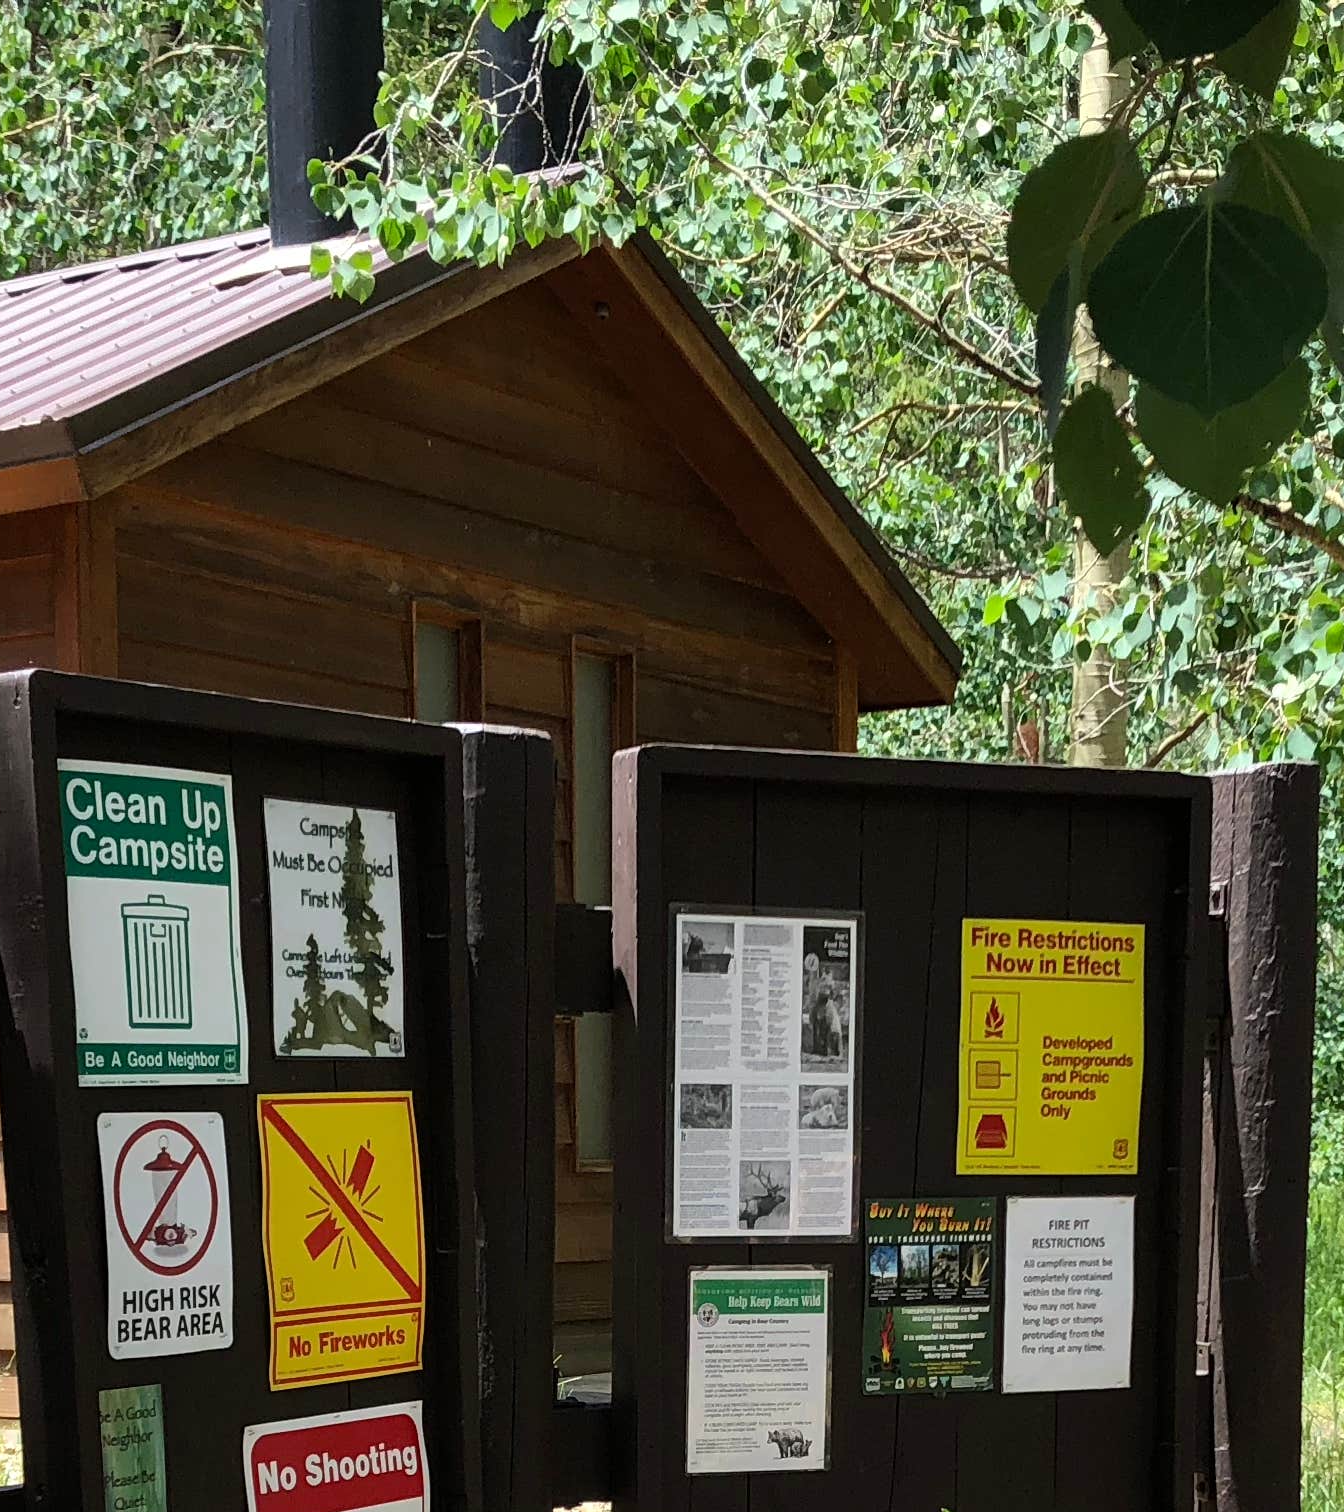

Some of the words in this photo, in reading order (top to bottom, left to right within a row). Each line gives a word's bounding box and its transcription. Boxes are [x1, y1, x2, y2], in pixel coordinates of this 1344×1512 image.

[66, 777, 167, 825] Clean
[181, 788, 221, 838] Up
[299, 817, 362, 849] Campsi
[70, 825, 224, 875] Campsite
[273, 850, 304, 870] Must
[307, 853, 325, 872] Be
[301, 889, 329, 908] First
[971, 926, 1011, 948] Fire
[1018, 928, 1135, 953] Restrictions
[986, 952, 1034, 974] Now
[1040, 954, 1056, 974] in
[1063, 955, 1121, 977] Effect
[1043, 1036, 1113, 1051] Developed
[85, 1052, 104, 1067] Be
[111, 1051, 122, 1067] A
[127, 1052, 162, 1067] Good
[168, 1051, 220, 1070] Neighbor
[1042, 1053, 1133, 1070] Campgrounds
[1042, 1071, 1066, 1083] and
[1070, 1070, 1109, 1083] Picnic
[1041, 1087, 1096, 1100] Grounds
[1041, 1104, 1071, 1120] Only
[1048, 1219, 1071, 1231] FIRE
[1074, 1219, 1090, 1231] PIT
[1032, 1237, 1105, 1249] RESTRICTIONS
[1037, 1258, 1077, 1269] campfires
[1079, 1259, 1099, 1267] must
[1102, 1257, 1113, 1267] be
[1023, 1273, 1069, 1284] completely
[1071, 1272, 1113, 1282] contained
[123, 1288, 174, 1314] HIGH
[180, 1284, 220, 1309] RISK
[1023, 1288, 1049, 1297] within
[1051, 1288, 1065, 1296] the
[1068, 1287, 1081, 1296] fire
[728, 1295, 748, 1310] Help
[750, 1295, 772, 1310] Keep
[773, 1295, 799, 1307] Bears
[801, 1295, 821, 1307] Wild
[1023, 1303, 1038, 1311] You
[1040, 1303, 1058, 1312] may
[1060, 1302, 1074, 1310] not
[1076, 1302, 1097, 1310] have
[118, 1316, 171, 1343] BEAR
[177, 1312, 224, 1337] AREA
[1022, 1317, 1041, 1327] long
[1042, 1316, 1059, 1326] logs
[1073, 1316, 1104, 1325] stumps
[289, 1335, 311, 1359] No
[319, 1325, 406, 1354] Fireworks
[1022, 1330, 1067, 1341] protruding
[1069, 1329, 1089, 1338] from
[1091, 1329, 1105, 1338] the
[1022, 1344, 1036, 1354] fire
[1038, 1344, 1055, 1355] ring
[1056, 1345, 1065, 1353] at
[1067, 1345, 1082, 1354] any
[114, 1408, 124, 1422] A
[126, 1399, 157, 1421] Good
[257, 1461, 297, 1495] No
[305, 1443, 418, 1486] Shooting
[114, 1495, 146, 1511] Quiet
